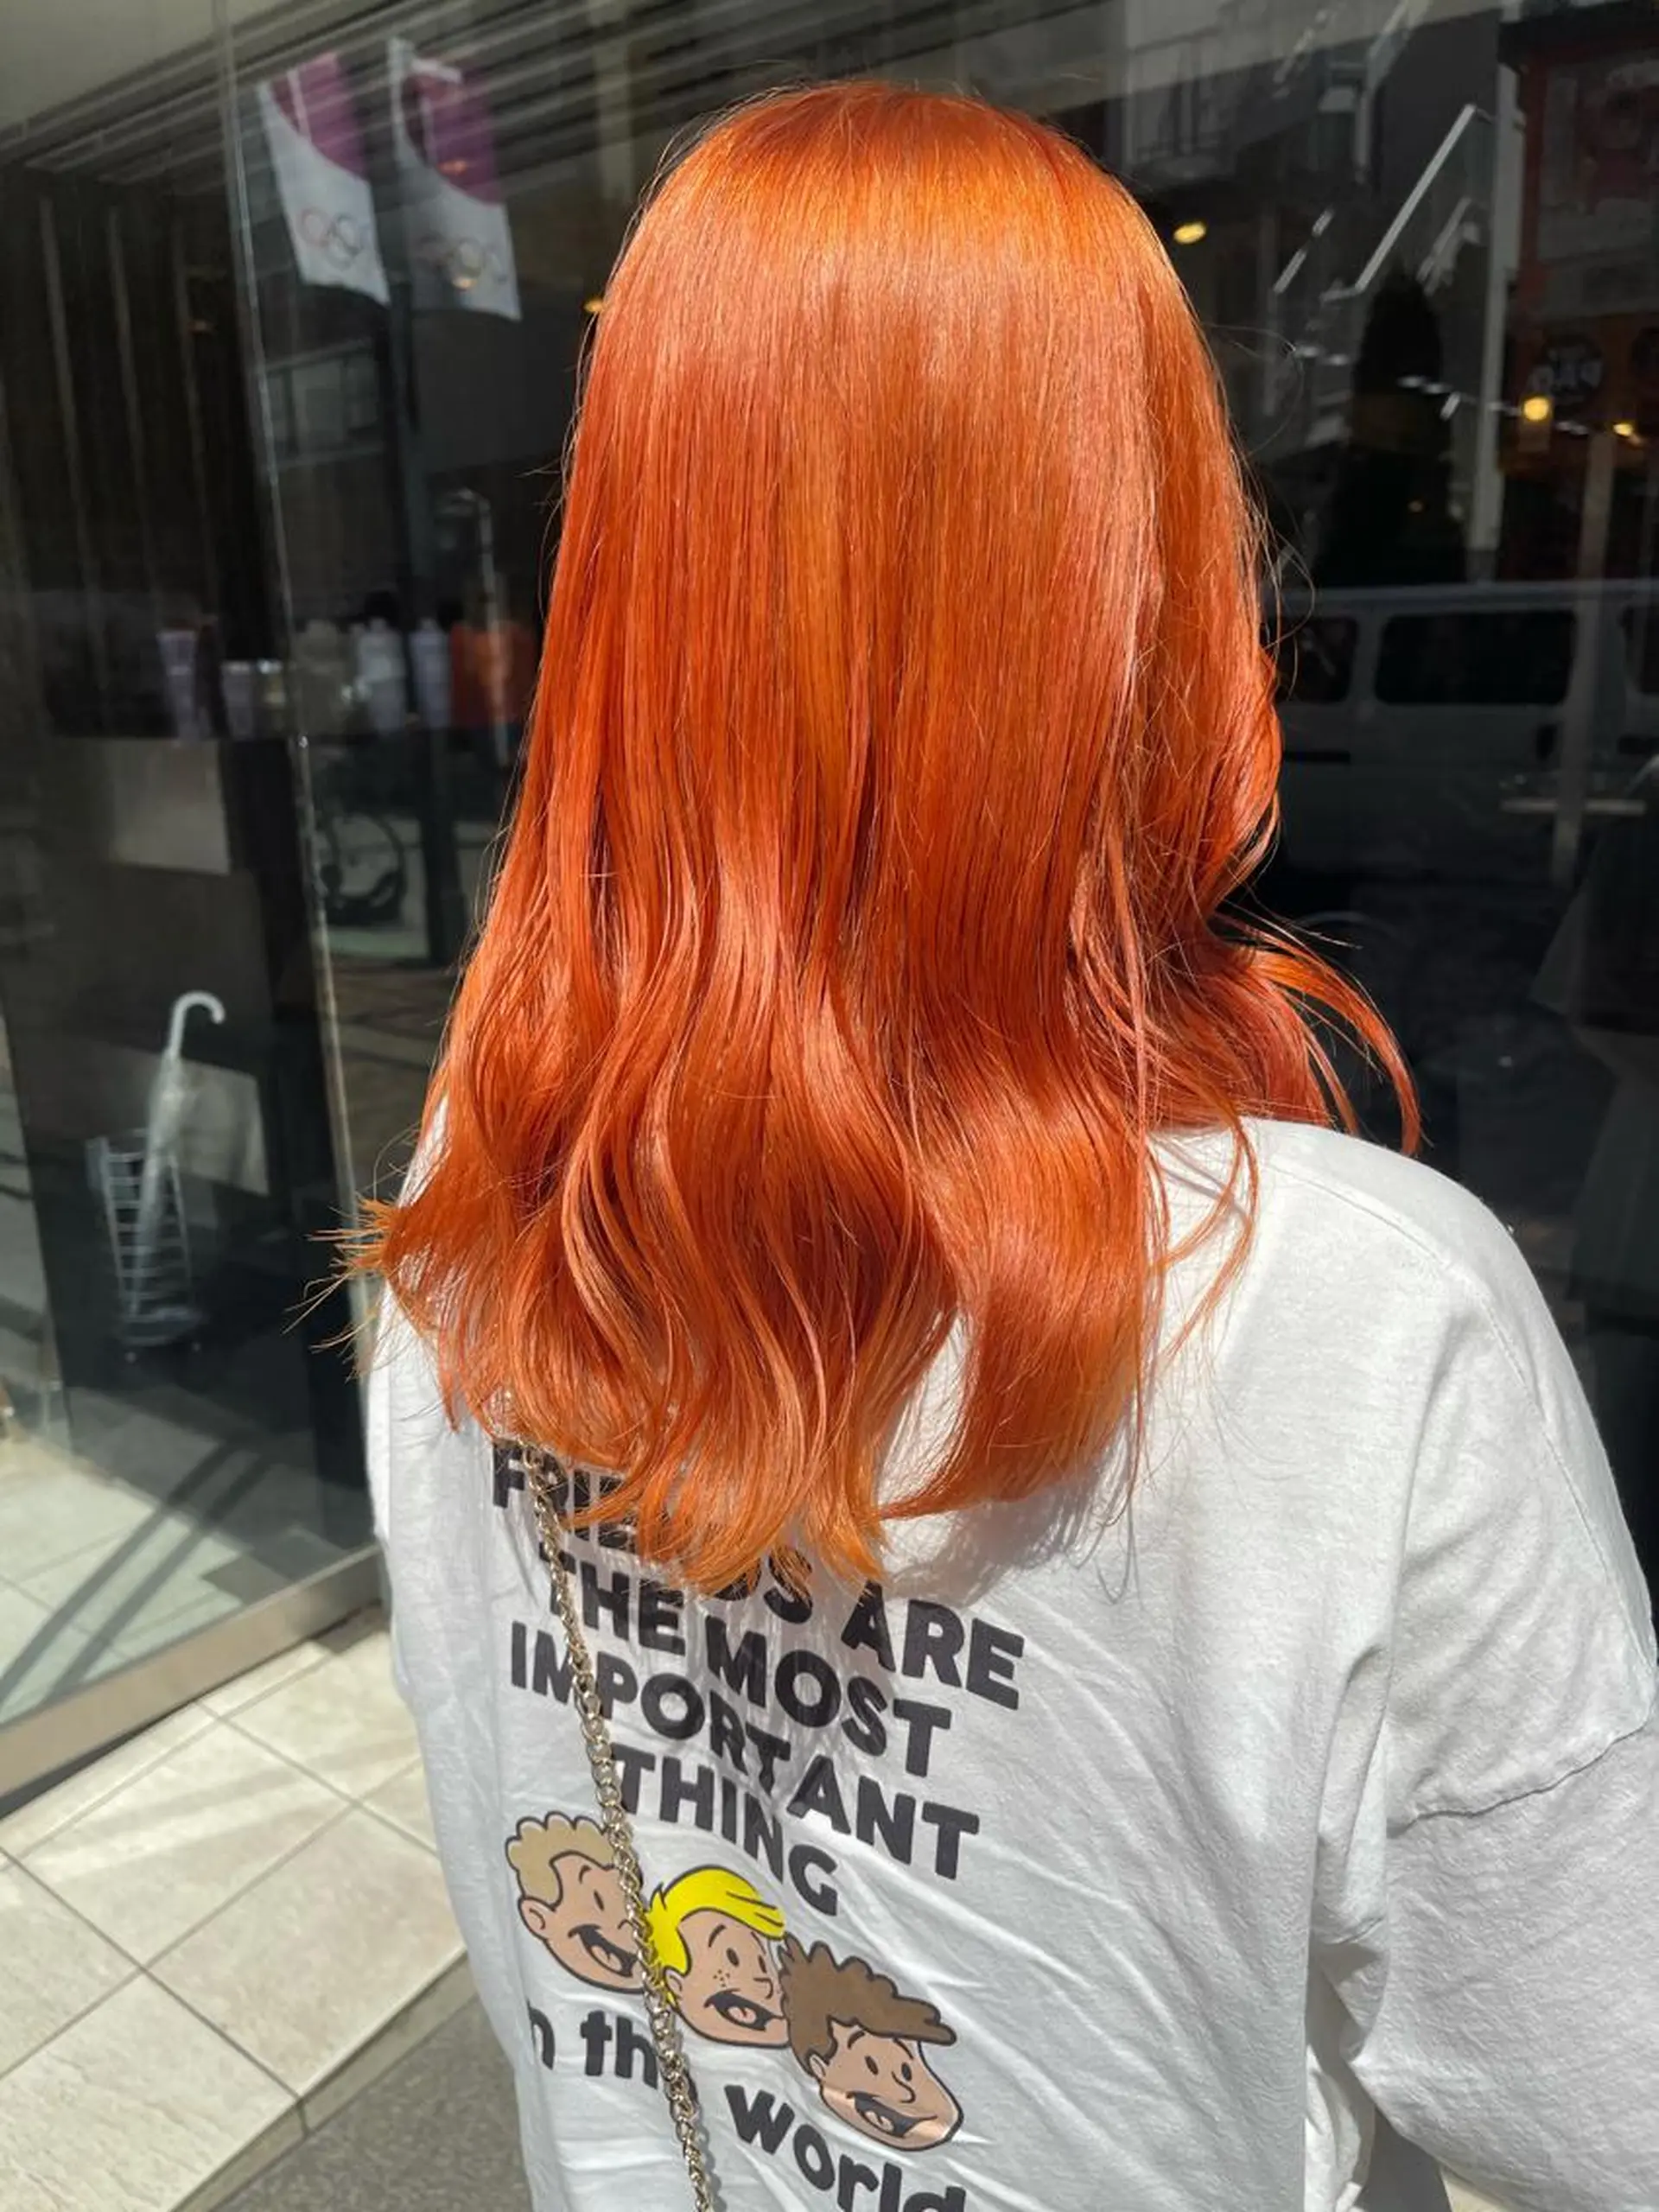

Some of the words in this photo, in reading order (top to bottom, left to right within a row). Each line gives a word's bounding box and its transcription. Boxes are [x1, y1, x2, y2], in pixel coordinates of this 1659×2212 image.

[493, 1437, 813, 1624] FRIES
[841, 1579, 1025, 1711] ARE
[538, 1541, 686, 1656] THE
[704, 1614, 952, 1778] MOST
[511, 1620, 980, 1880] IMPORTANT
[610, 1742, 838, 1917] THING
[580, 2009, 698, 2103] th
